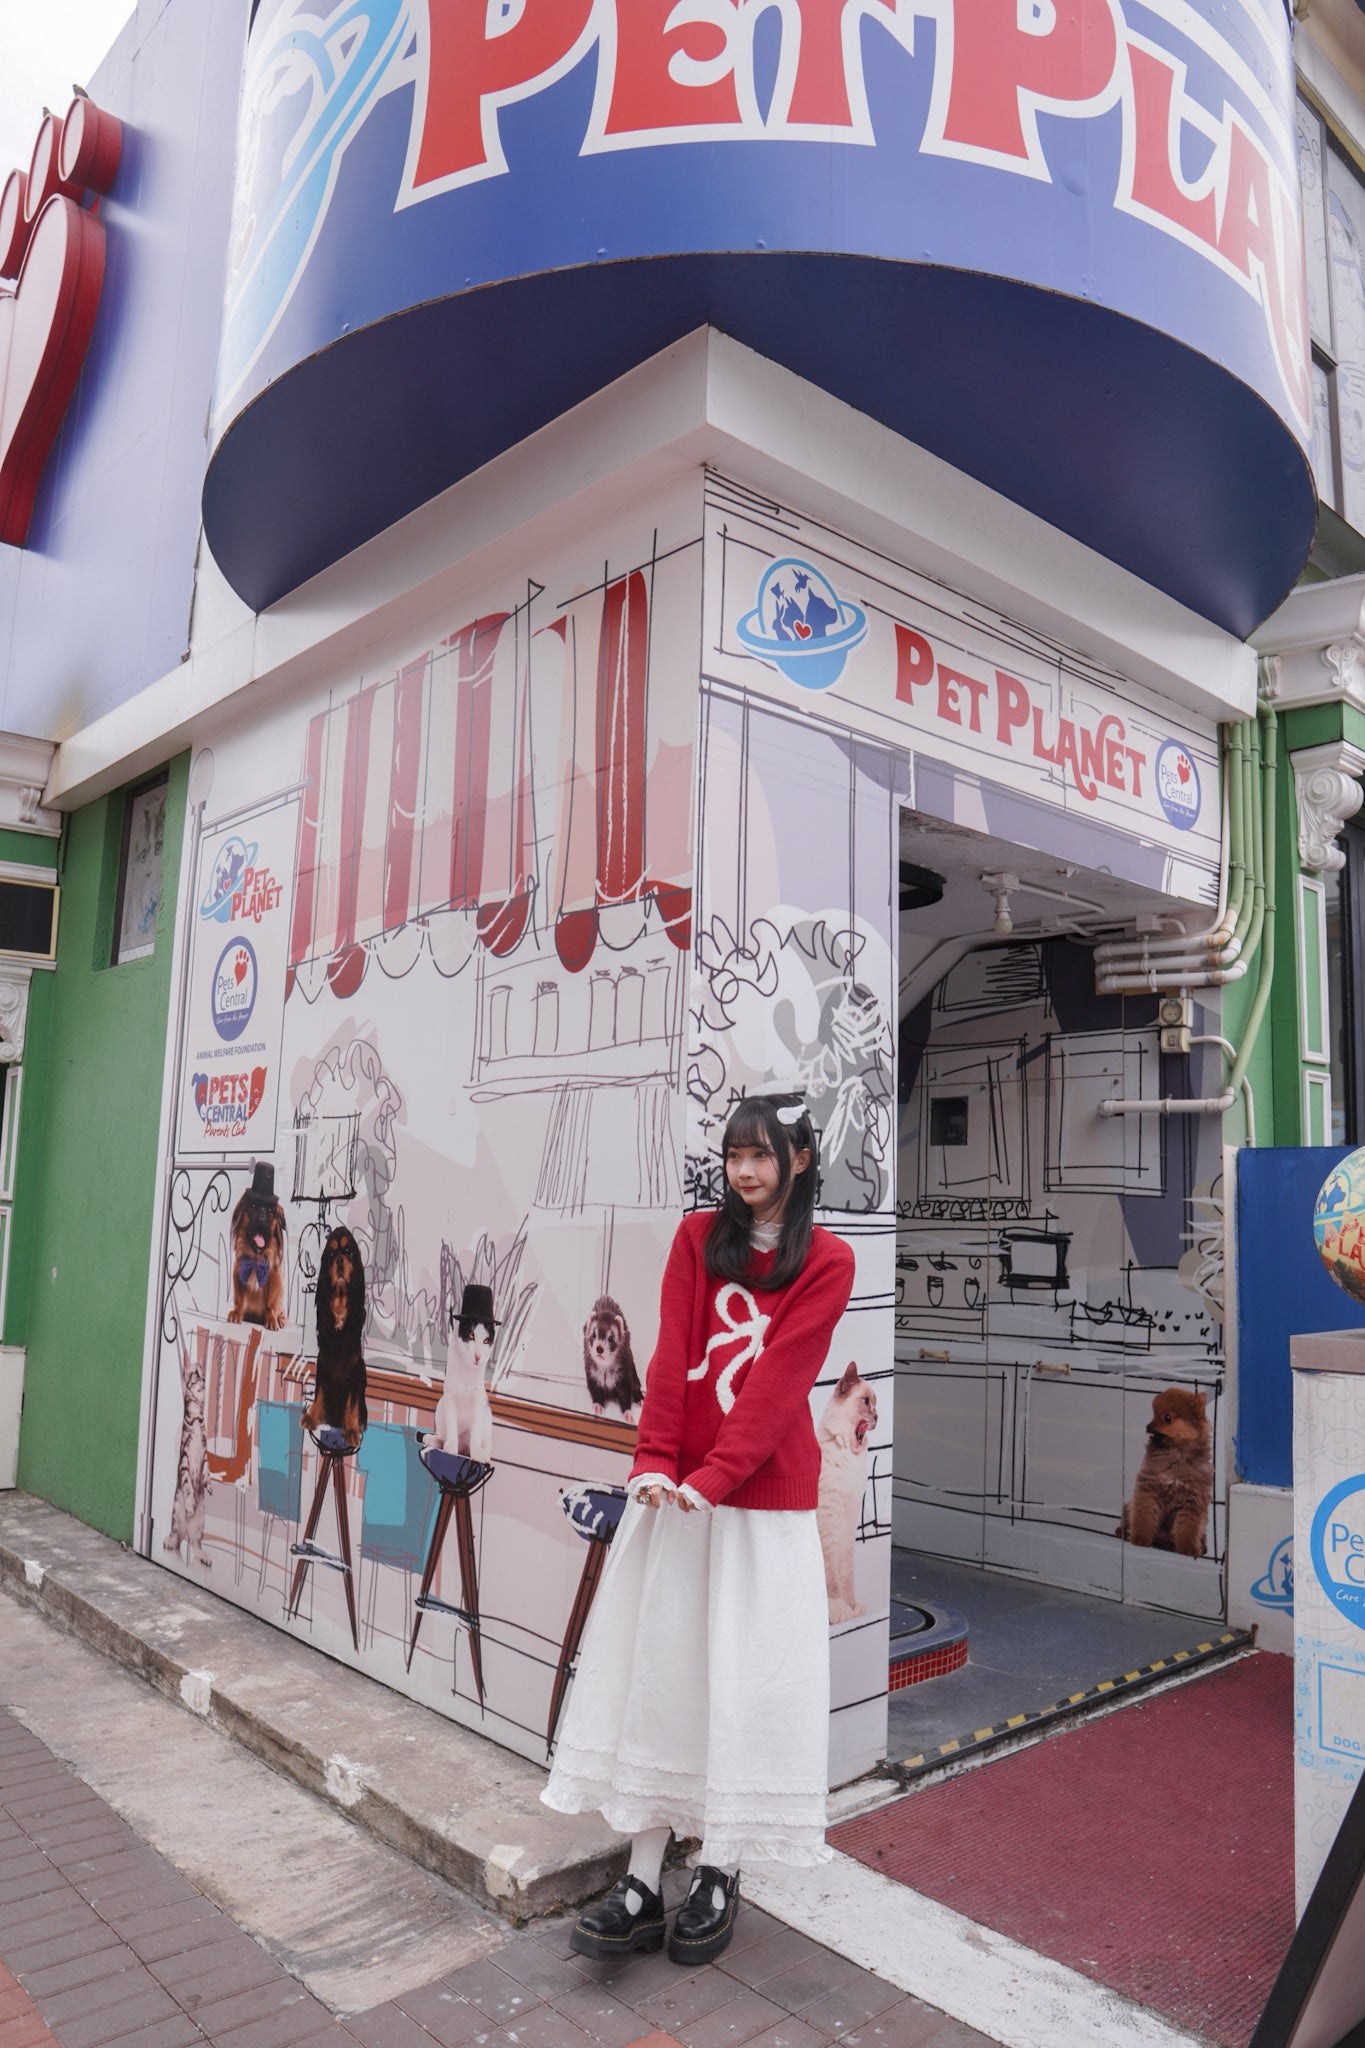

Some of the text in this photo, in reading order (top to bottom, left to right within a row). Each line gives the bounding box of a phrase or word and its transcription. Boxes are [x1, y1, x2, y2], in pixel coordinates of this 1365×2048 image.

[894, 623, 1147, 801] PET PLANET
[1161, 763, 1178, 784] Pets
[1165, 781, 1193, 805] Central
[242, 866, 270, 897] PET
[230, 876, 283, 924] PLANET
[217, 975, 234, 995] Pets
[220, 986, 248, 1011] Central
[234, 1042, 266, 1055] FOUNDATION
[208, 1072, 249, 1105] PETS
[206, 1103, 248, 1122] CENTRAL
[1325, 1222, 1365, 1270] PLA
[1331, 1522, 1365, 1553] Pe
[1344, 1553, 1365, 1585] C
[1335, 1588, 1360, 1602] Care
